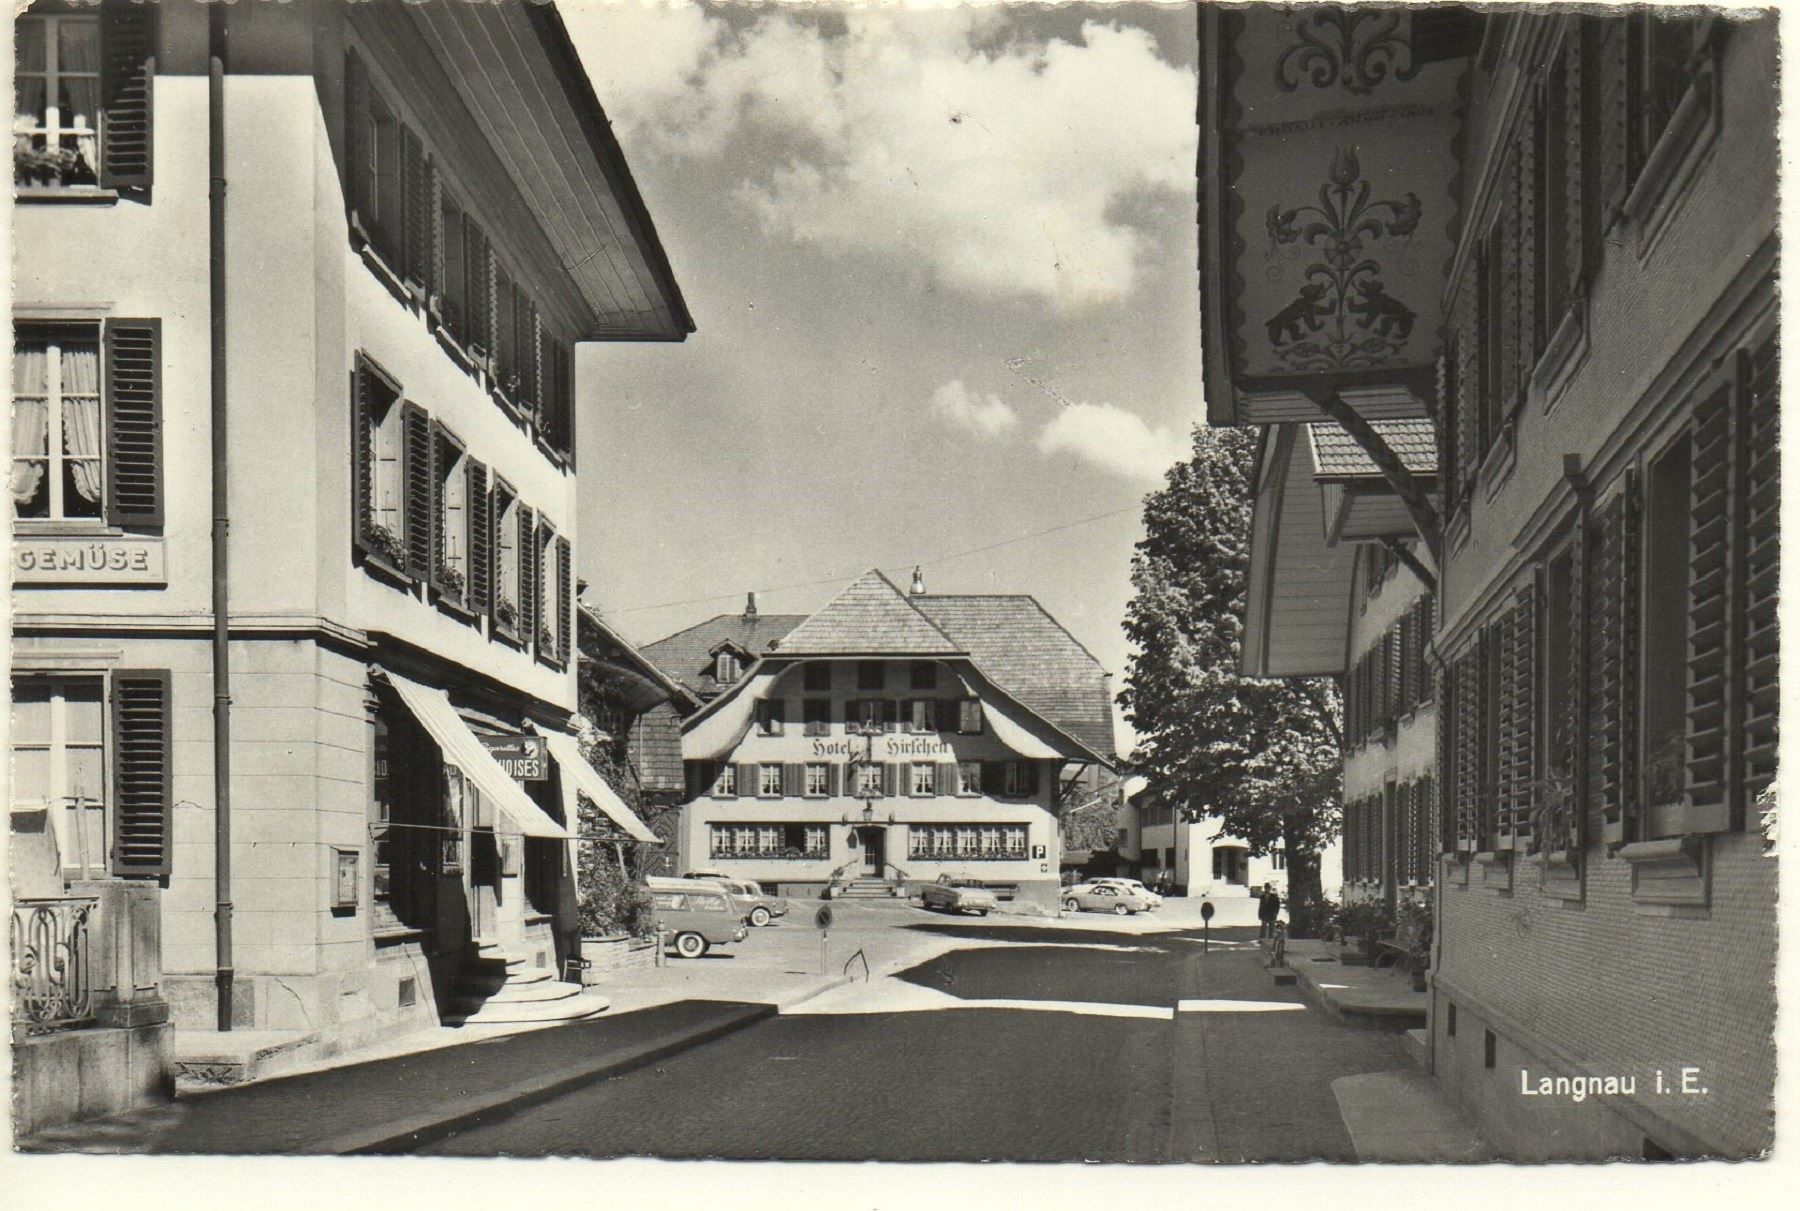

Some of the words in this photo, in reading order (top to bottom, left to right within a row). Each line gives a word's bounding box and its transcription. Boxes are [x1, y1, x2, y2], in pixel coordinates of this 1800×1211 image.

[16, 543, 148, 571] GEMÜSE
[813, 738, 851, 757] Hotel
[886, 738, 949, 756] Hirschen
[1036, 846, 1044, 858] P
